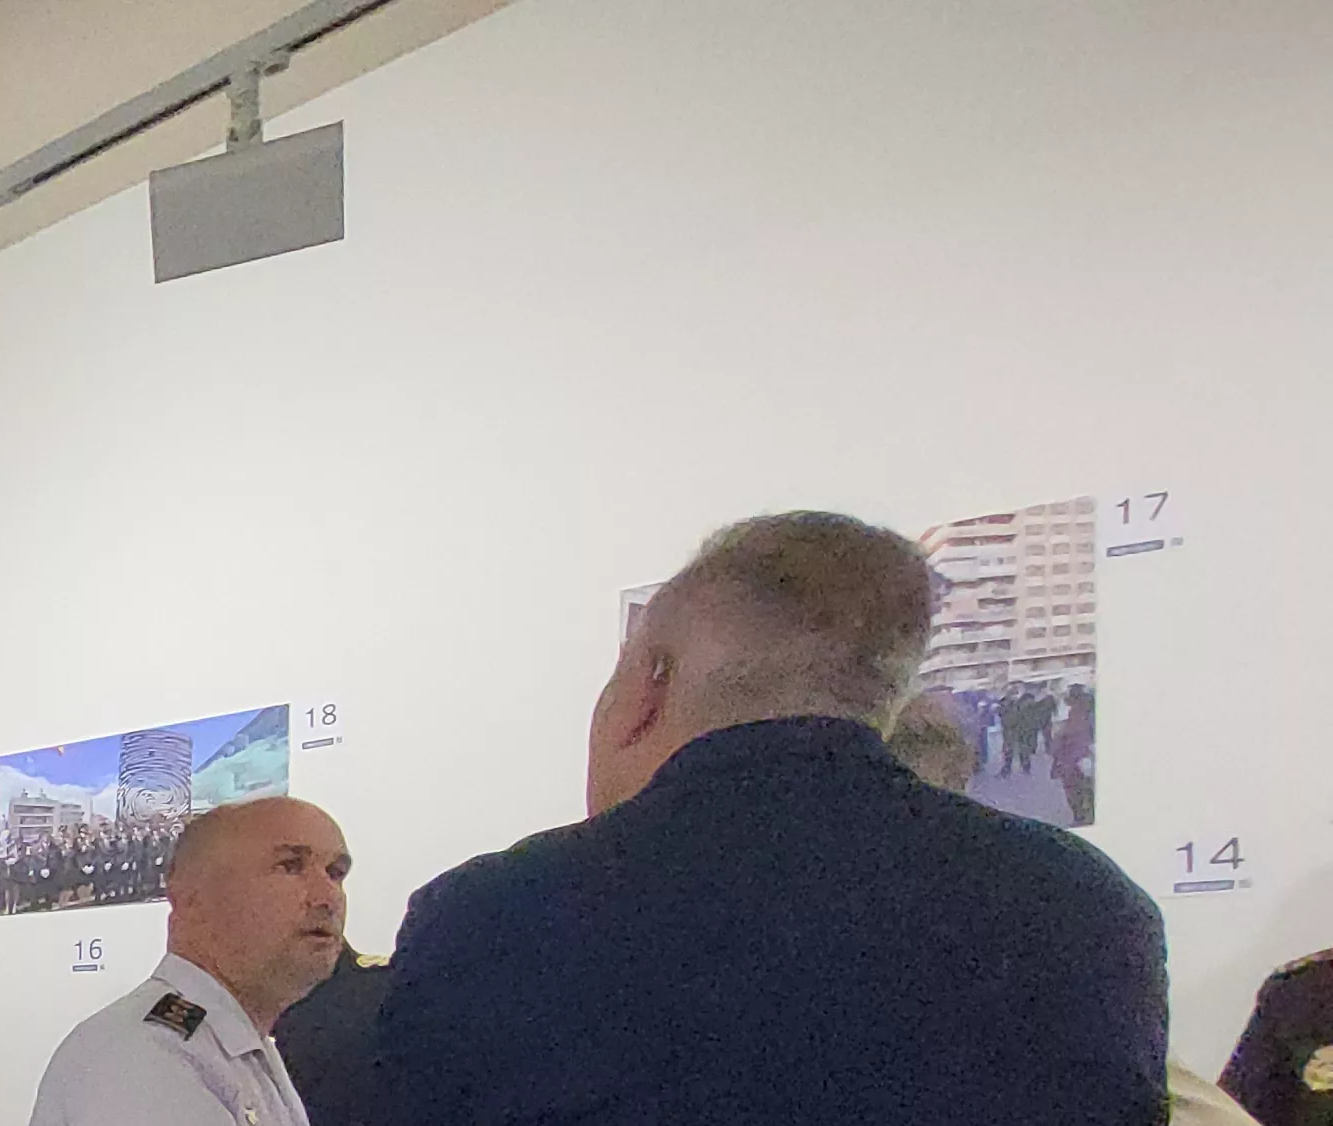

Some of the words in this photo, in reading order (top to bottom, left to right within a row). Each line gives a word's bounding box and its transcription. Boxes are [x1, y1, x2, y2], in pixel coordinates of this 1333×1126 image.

[1115, 491, 1169, 525] 17
[305, 703, 337, 728] 18
[1176, 837, 1245, 873] 14
[74, 938, 103, 960] 16
